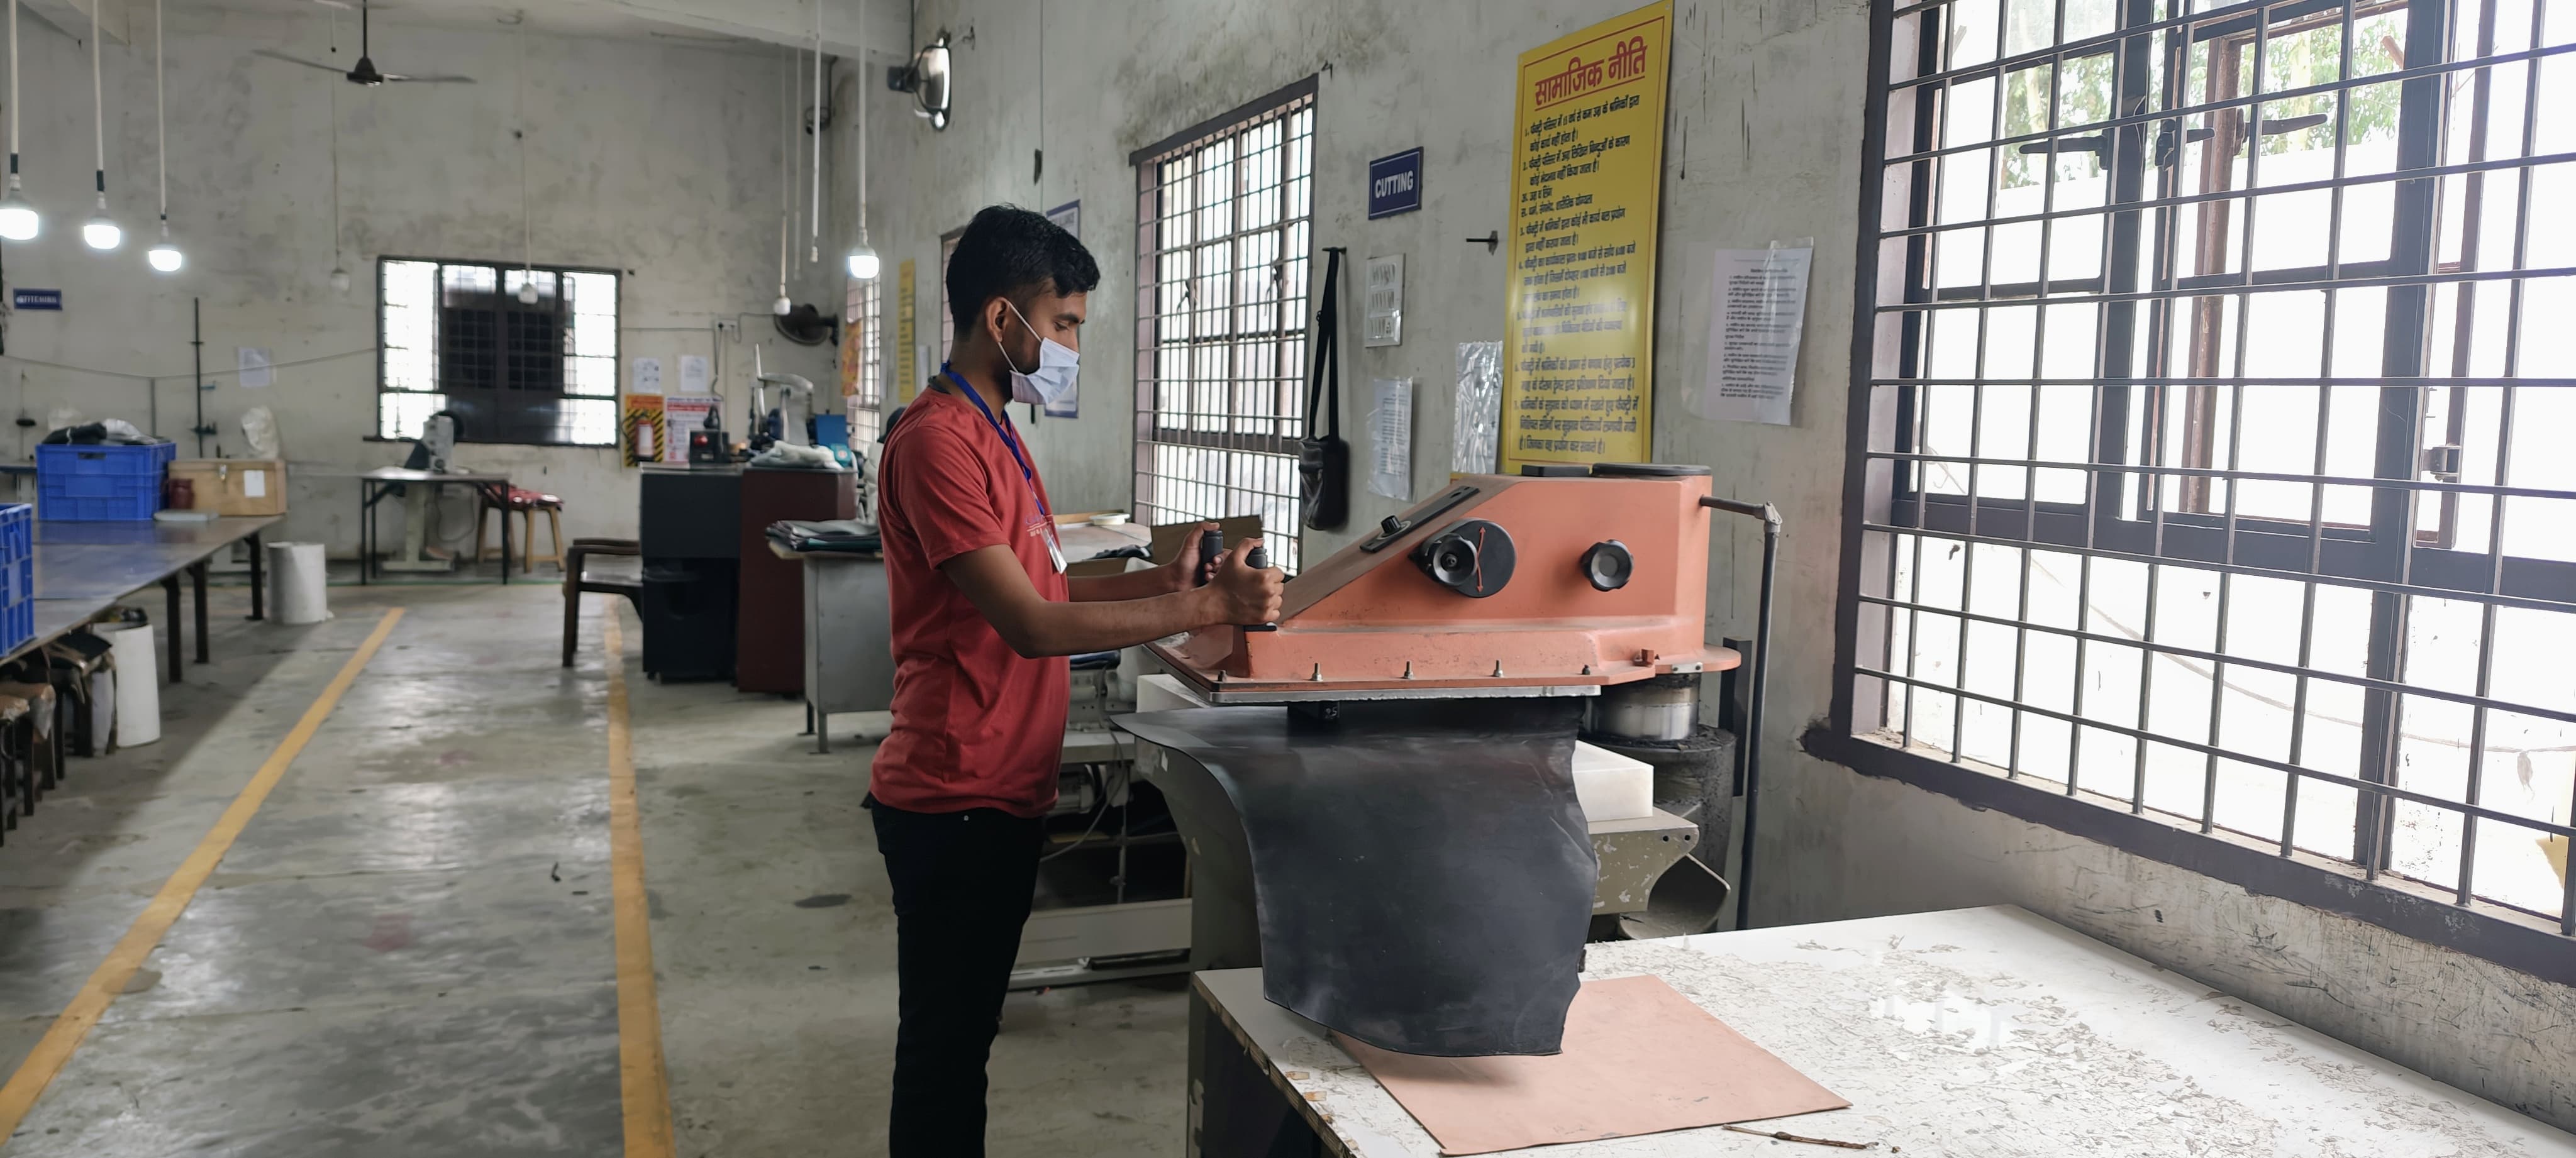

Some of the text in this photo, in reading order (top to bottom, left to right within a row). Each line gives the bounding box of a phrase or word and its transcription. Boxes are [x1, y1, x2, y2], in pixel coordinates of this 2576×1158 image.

[1535, 36, 1648, 106] सामाजिक नीति
[1375, 170, 1414, 199] CUTTING
